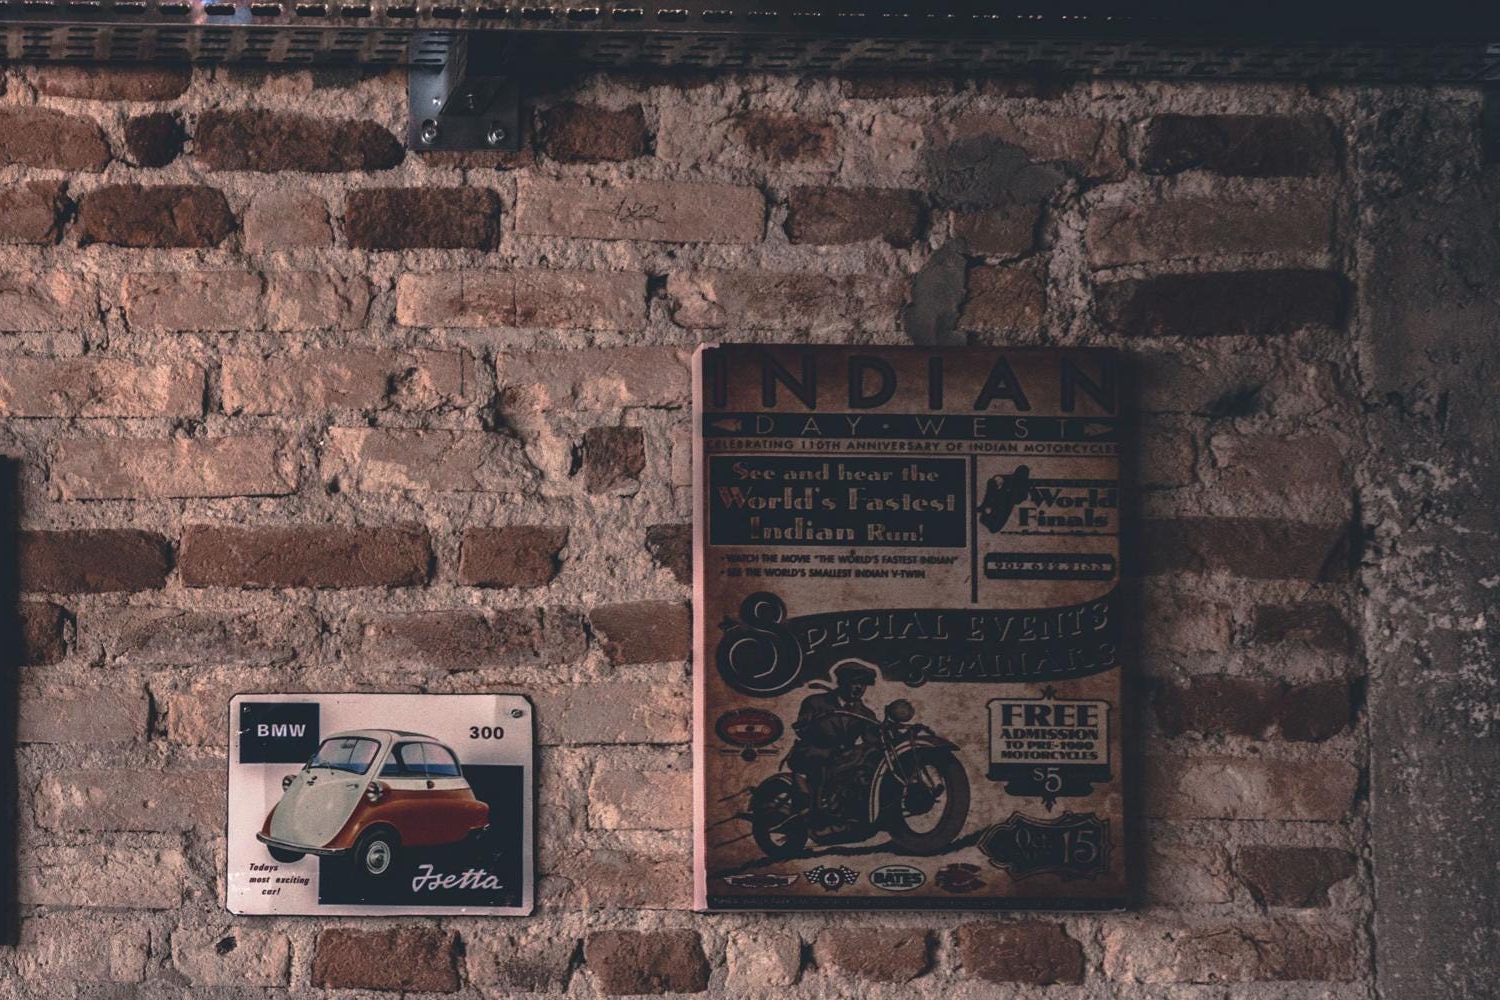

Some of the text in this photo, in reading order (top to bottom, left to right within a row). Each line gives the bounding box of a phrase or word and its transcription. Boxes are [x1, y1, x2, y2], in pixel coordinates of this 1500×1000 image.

[713, 354, 1117, 415] INDIAN
[755, 415, 1069, 439] DAY WEST
[707, 439, 794, 450] CELEBRATING
[801, 440, 840, 450] 110TH
[847, 440, 938, 451] ANNIVERSARY
[945, 441, 963, 451] OF
[969, 442, 1019, 452] INDIAN
[732, 461, 940, 482] See and hear the
[717, 486, 956, 511] World's Fastest
[1029, 488, 1117, 508] World
[1018, 507, 1109, 527] Finals
[750, 516, 924, 542] Indian Run!
[781, 555, 811, 564] MOVIE
[837, 556, 880, 564] WORLD'S
[882, 556, 918, 565] FASTEST
[745, 568, 762, 577] THE
[765, 568, 807, 577] WORLD'S
[808, 569, 852, 578] SMALLEST
[854, 569, 889, 578] INDIAN
[1000, 703, 1099, 728] FREE
[257, 723, 505, 740] BMW 300
[1000, 728, 1099, 740] ADMISSION
[1004, 741, 1025, 750] TO
[1000, 750, 1099, 761] MOTORCYCLES
[1062, 829, 1100, 864] 15
[249, 863, 279, 873] Todays
[249, 875, 310, 886] most exciting
[411, 863, 504, 893] Isetta
[261, 887, 281, 895] car!
